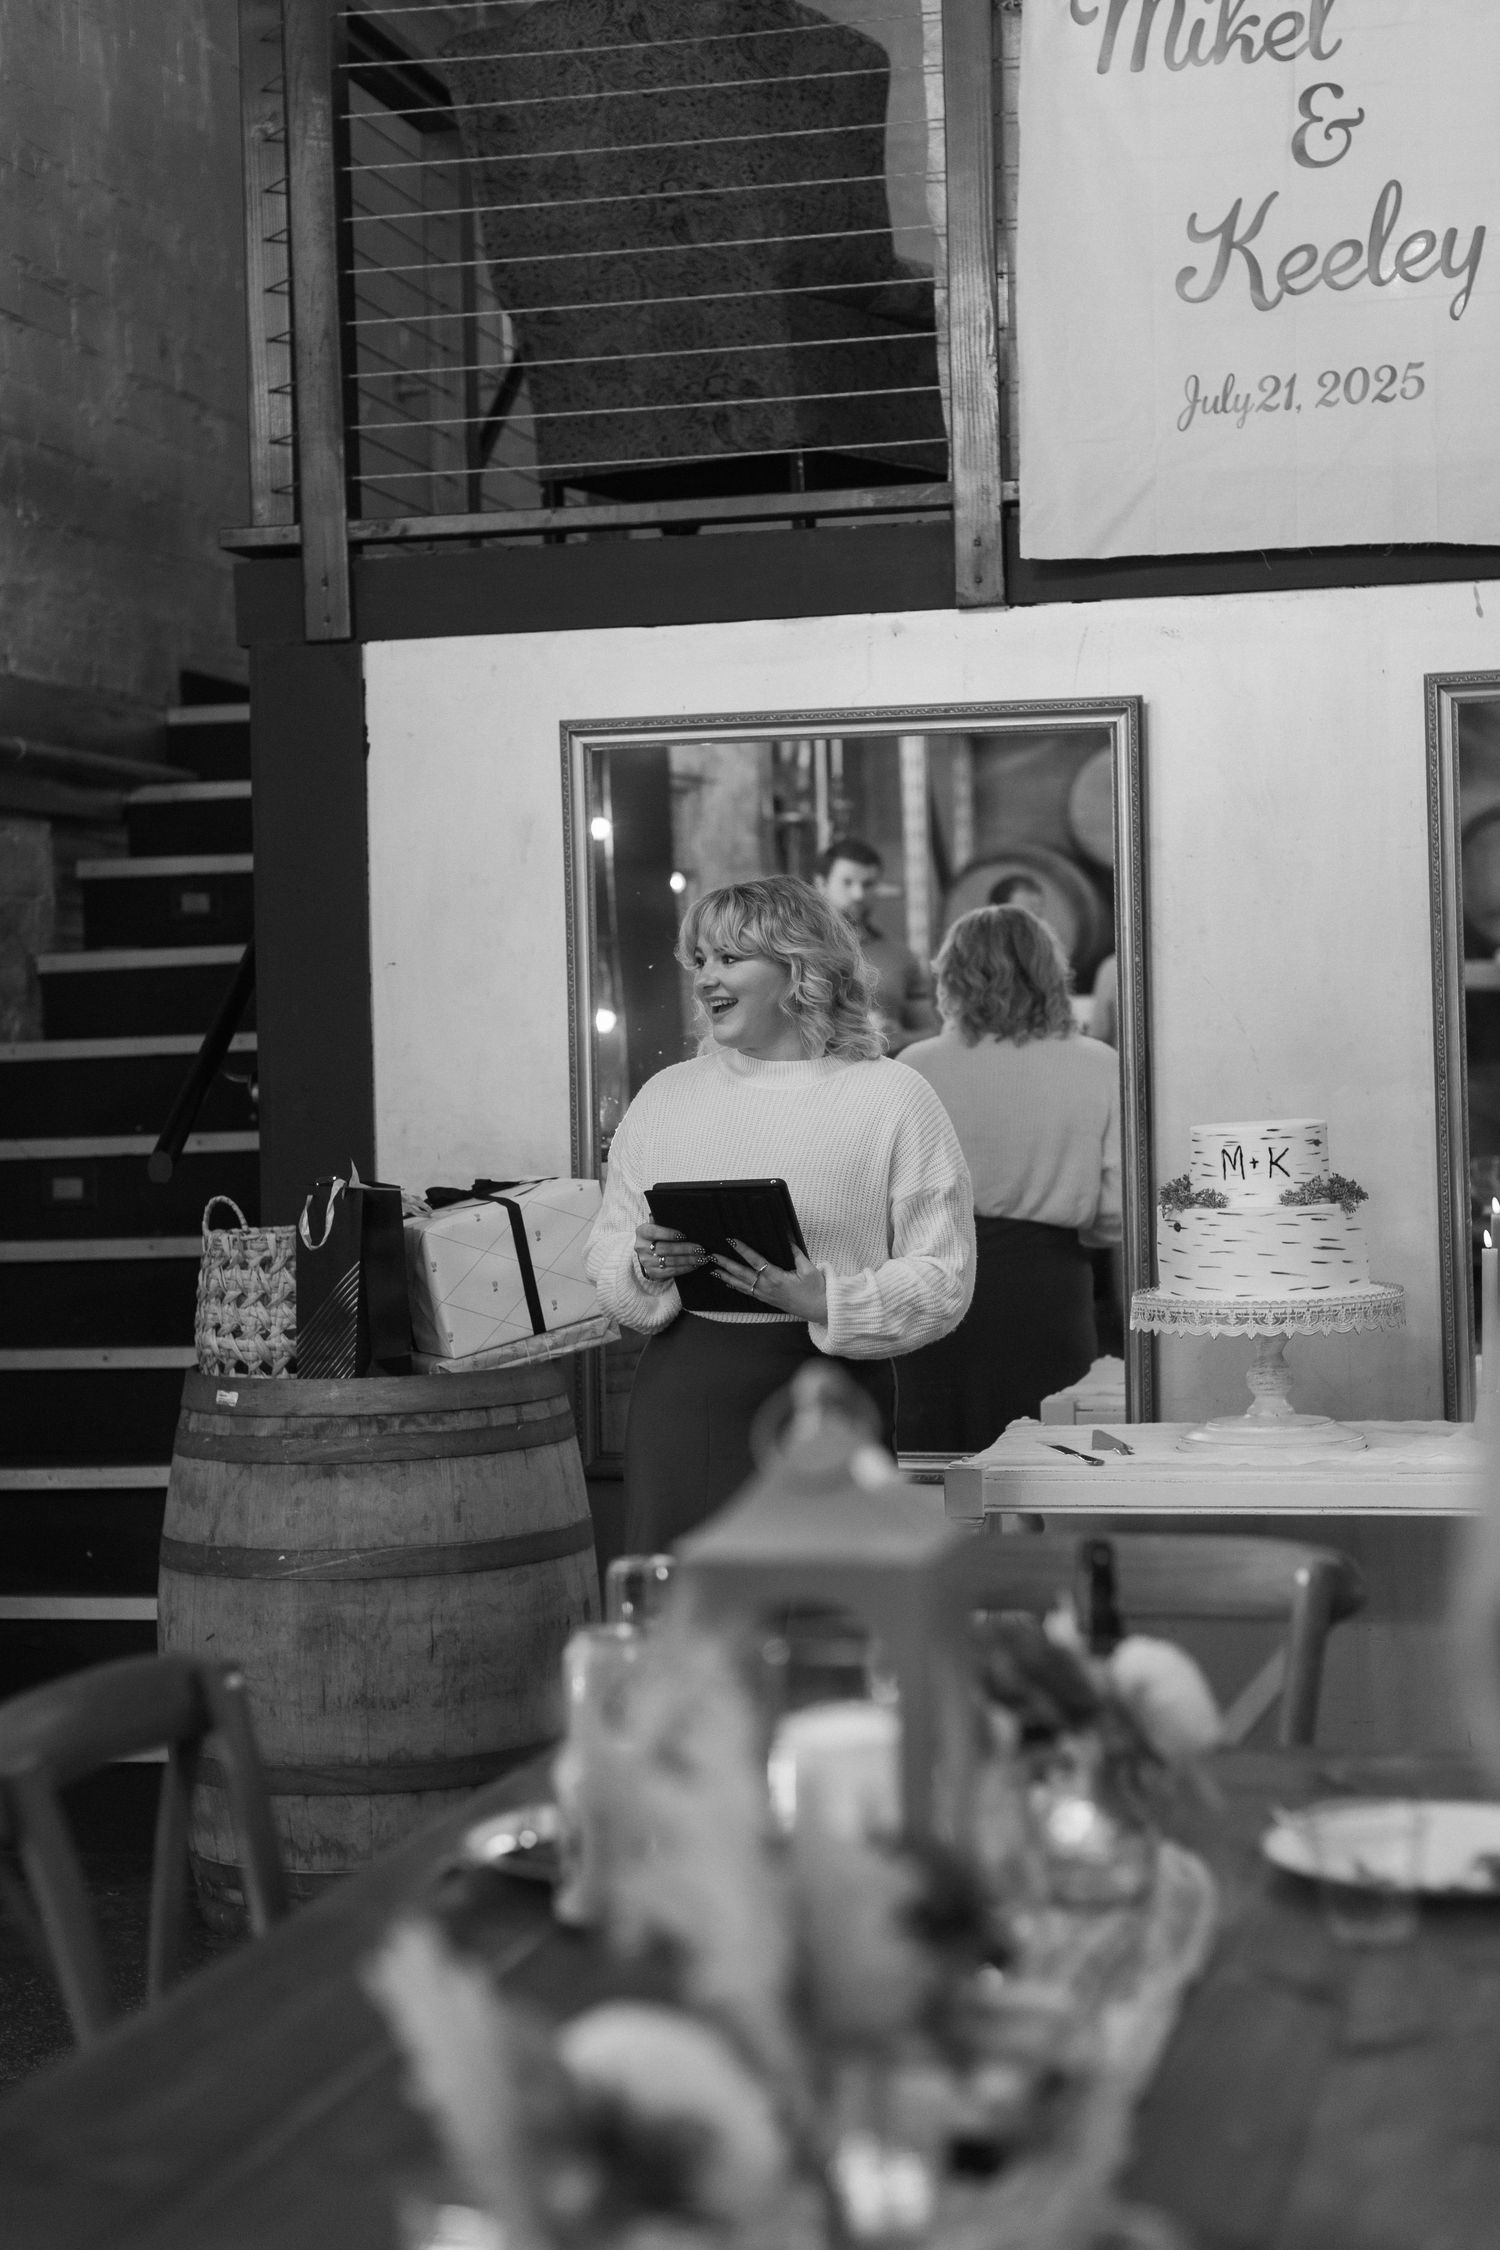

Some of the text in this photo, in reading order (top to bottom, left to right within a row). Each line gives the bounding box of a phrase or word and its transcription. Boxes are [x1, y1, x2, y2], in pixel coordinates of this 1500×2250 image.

[1070, 0, 1342, 75] Mikel
[1292, 82, 1365, 168] &
[1175, 179, 1487, 321] Keeley
[1315, 361, 1425, 409] 2025
